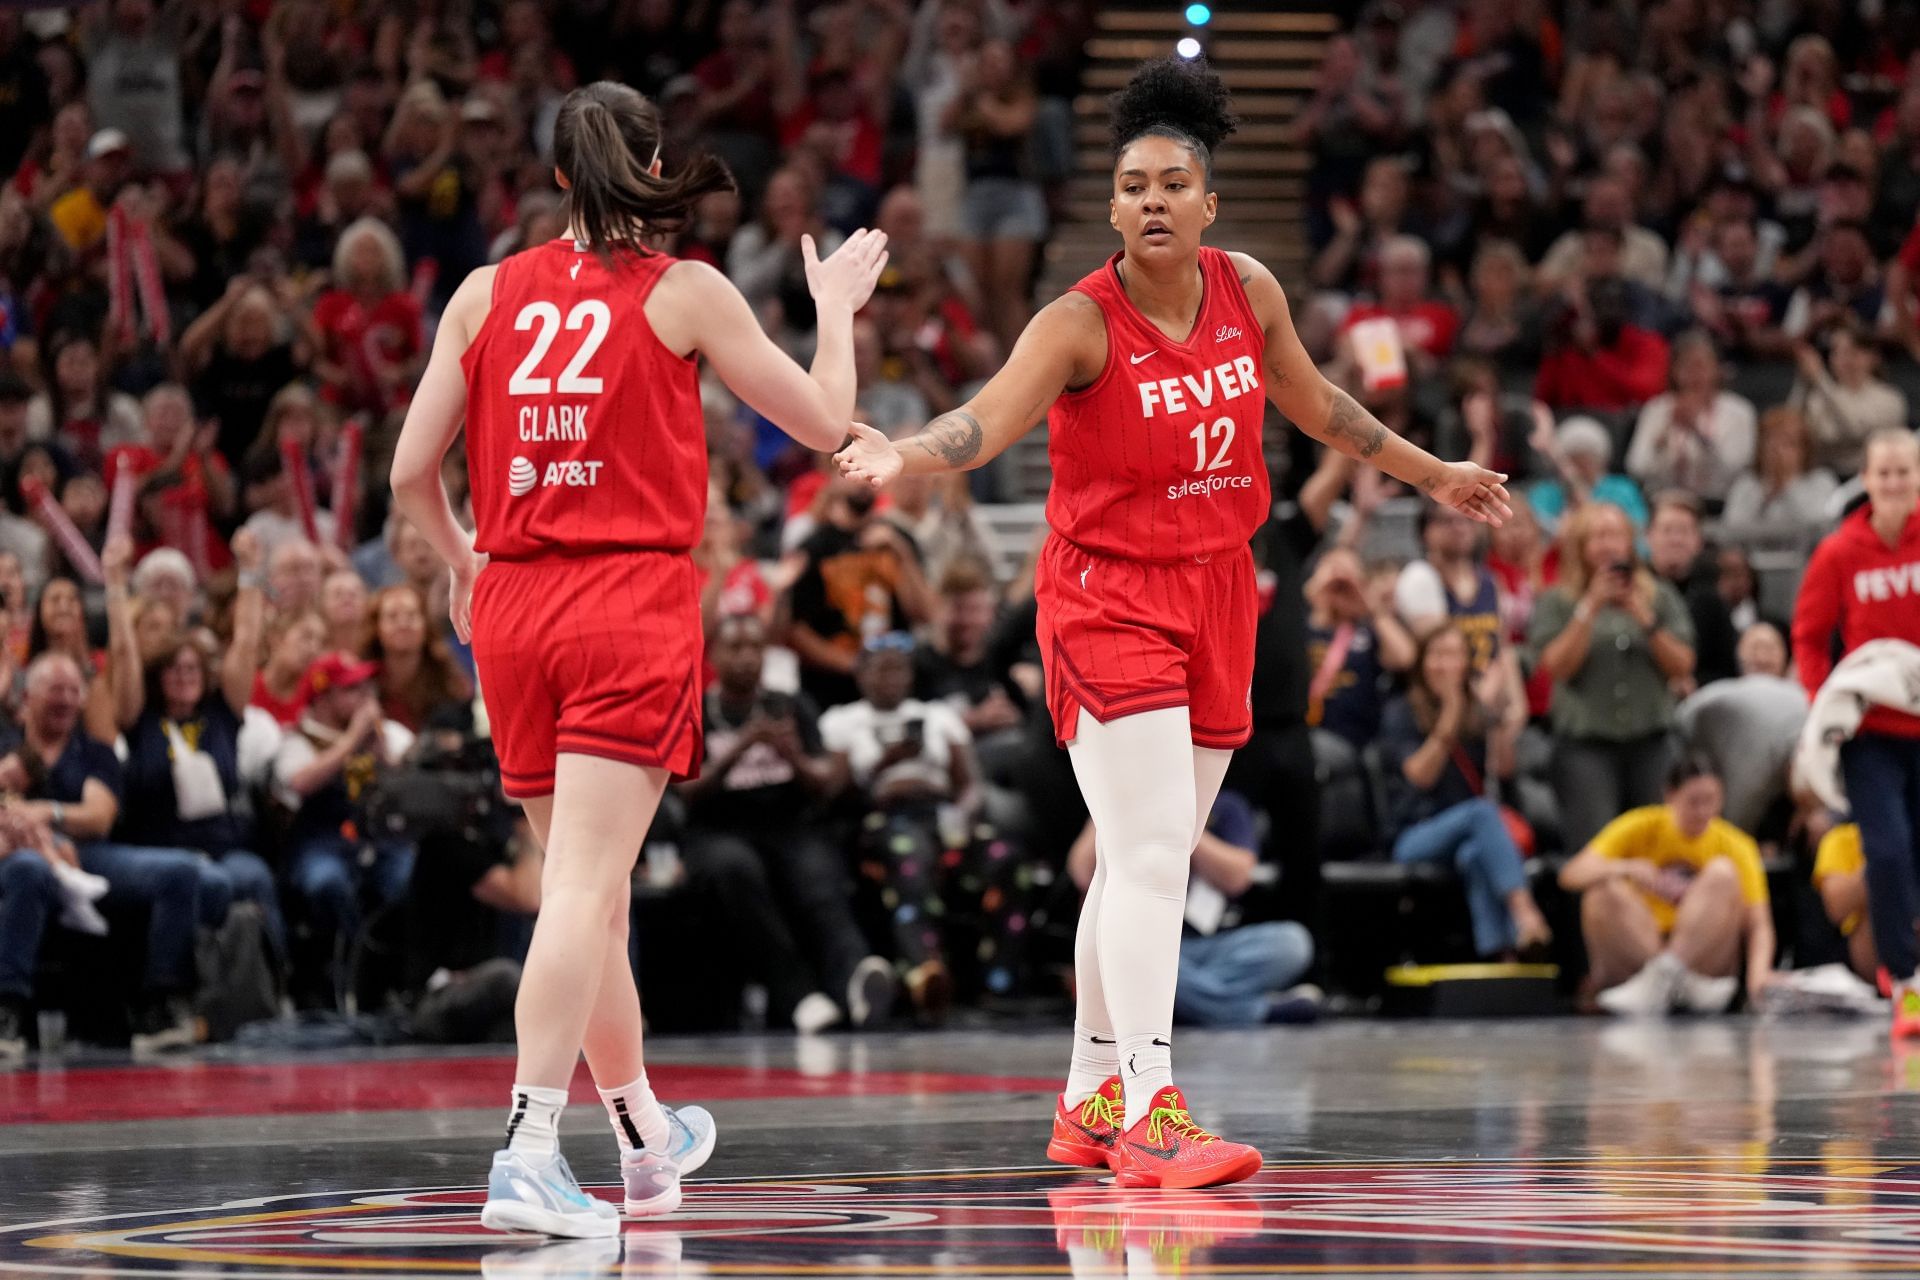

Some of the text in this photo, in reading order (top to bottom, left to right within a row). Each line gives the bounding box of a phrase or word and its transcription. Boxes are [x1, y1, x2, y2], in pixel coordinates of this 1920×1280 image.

[508, 299, 611, 395] 22
[1215, 325, 1243, 343] Lilly
[1138, 355, 1259, 418] FEVER
[519, 405, 588, 442] CLARK
[1189, 416, 1236, 472] 12
[542, 460, 604, 487] AT&T
[1167, 474, 1252, 500] salesforce
